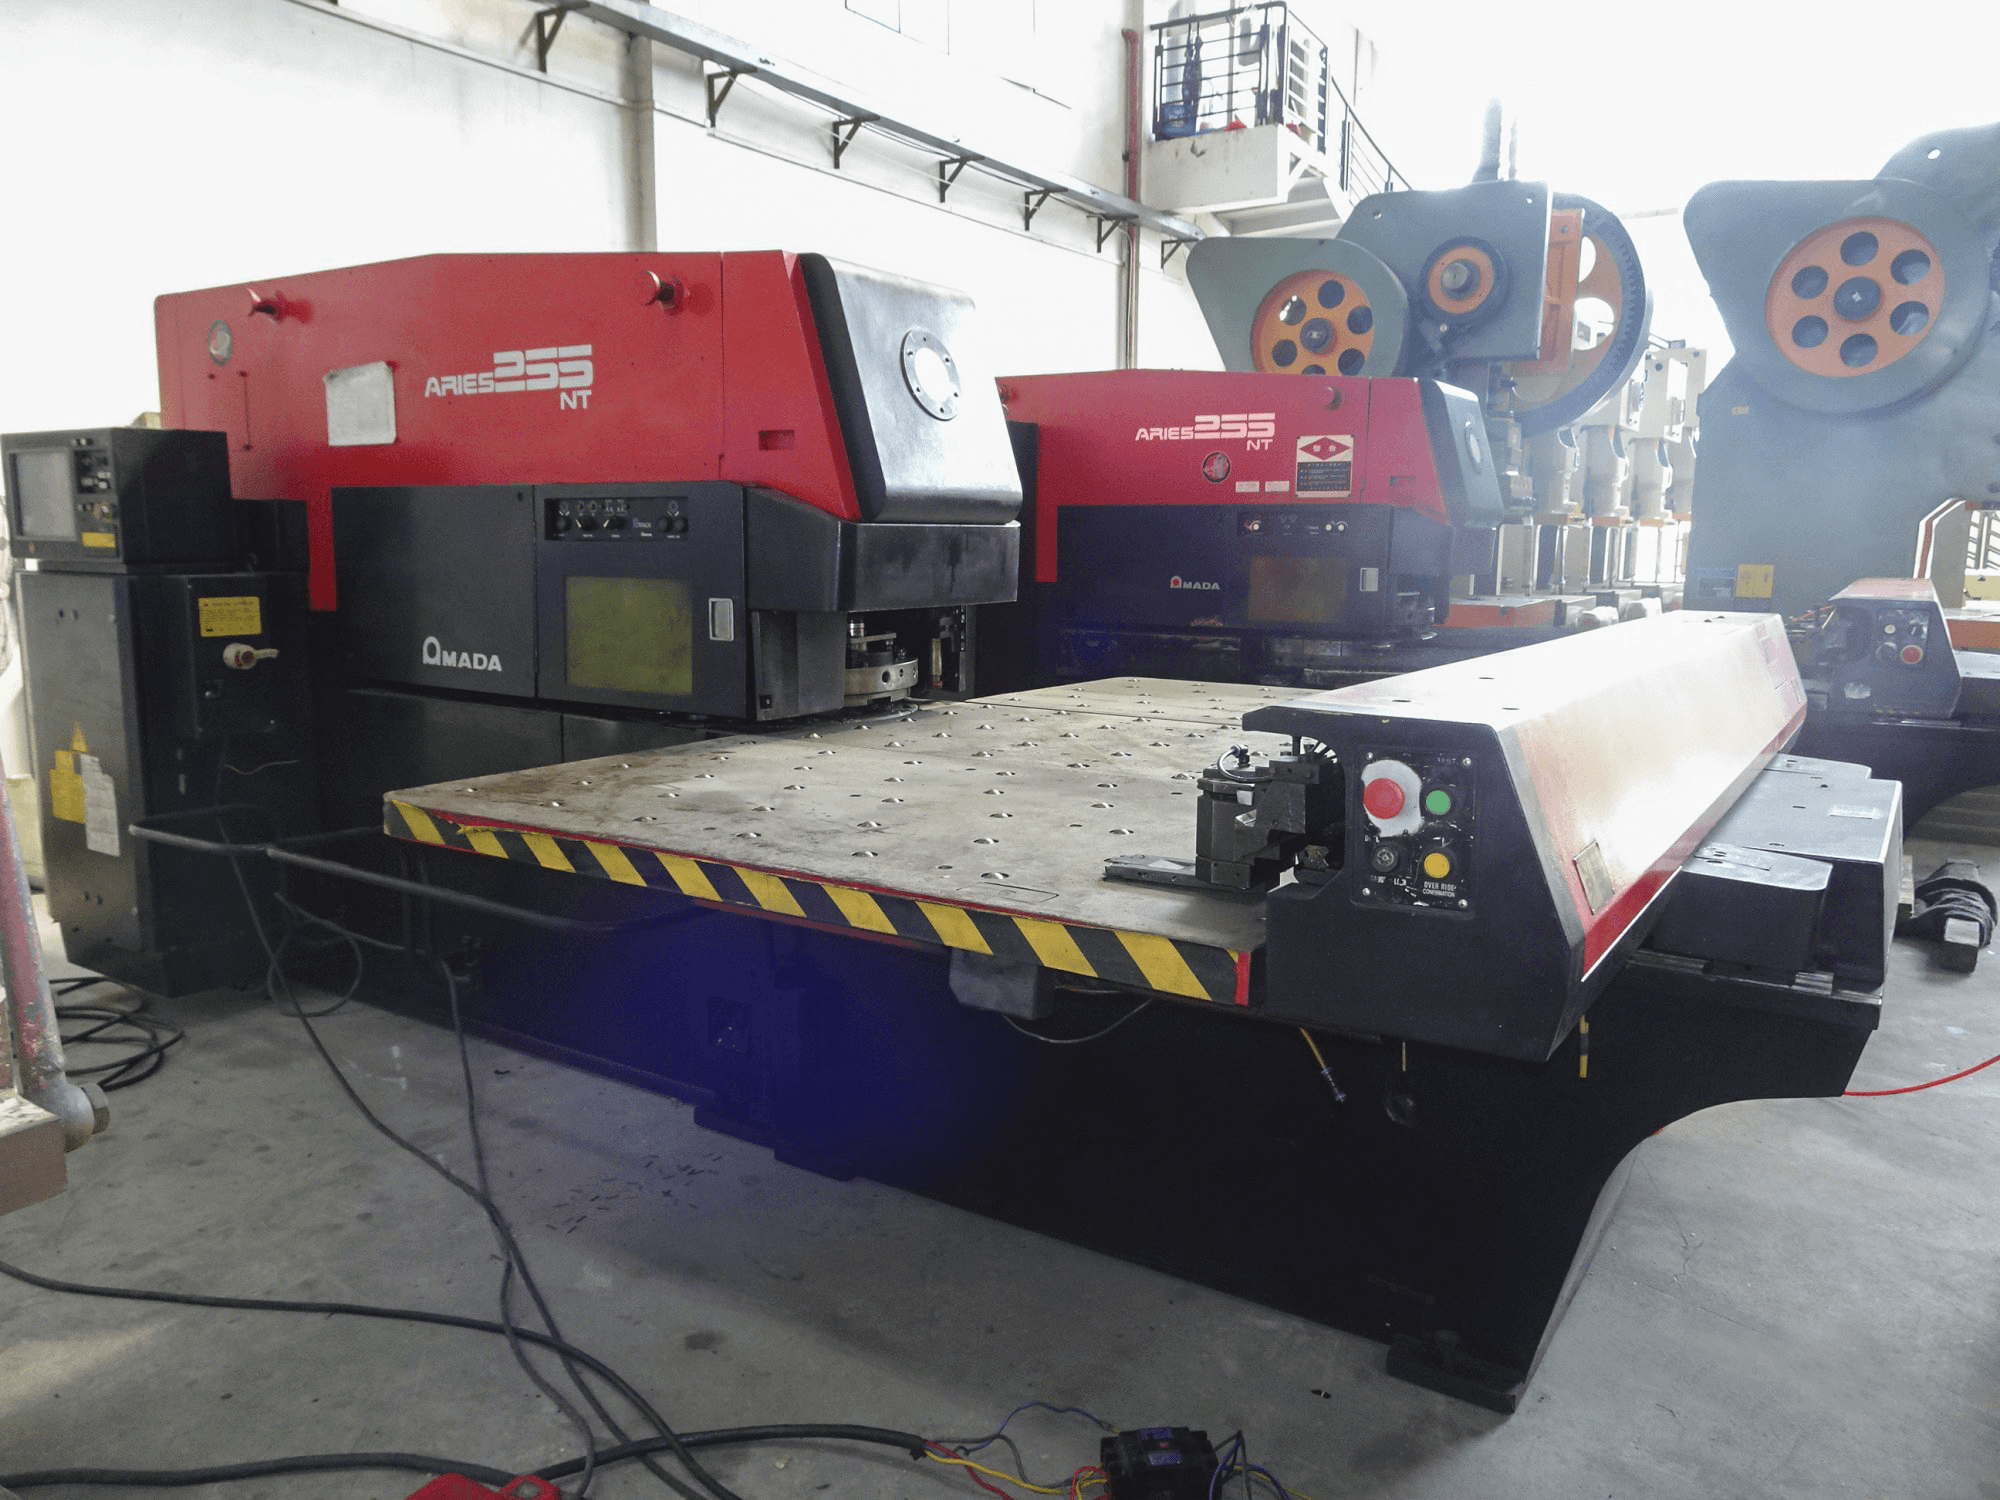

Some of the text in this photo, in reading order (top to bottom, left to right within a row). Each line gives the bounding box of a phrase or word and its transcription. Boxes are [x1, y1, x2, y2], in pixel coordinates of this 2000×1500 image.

[559, 389, 592, 410] NT
[1246, 438, 1273, 451] NT
[1170, 575, 1220, 590] AMADA
[422, 635, 502, 672] AMADA
[1422, 888, 1455, 898] CONFIRMATION
[1424, 881, 1455, 891] OVER RIDE
